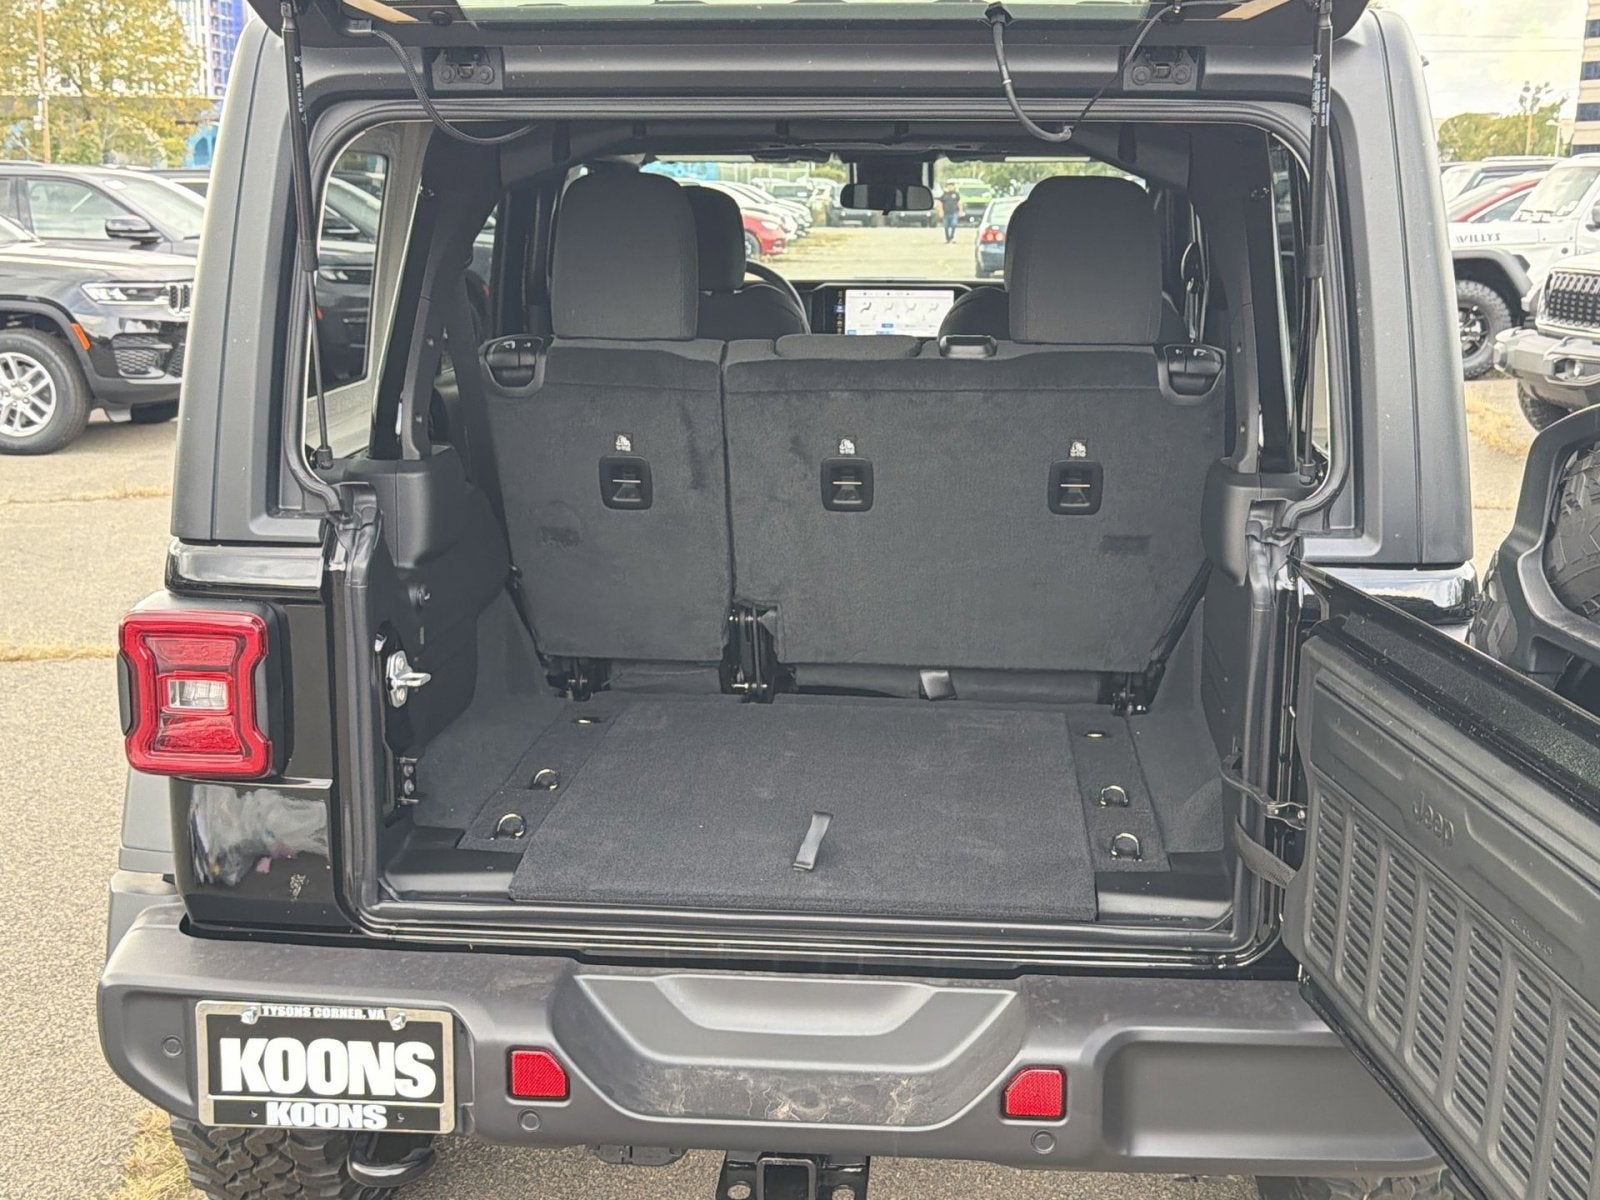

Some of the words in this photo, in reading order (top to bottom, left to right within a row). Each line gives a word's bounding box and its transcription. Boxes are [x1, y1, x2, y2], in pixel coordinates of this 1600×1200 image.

[1456, 233, 1501, 243] WILLYS
[1413, 792, 1455, 845] Jeep
[262, 1005, 311, 1018] TYSONS
[368, 1007, 386, 1020] VA
[220, 1036, 437, 1098] KOONS
[266, 1101, 388, 1130] KOONS
